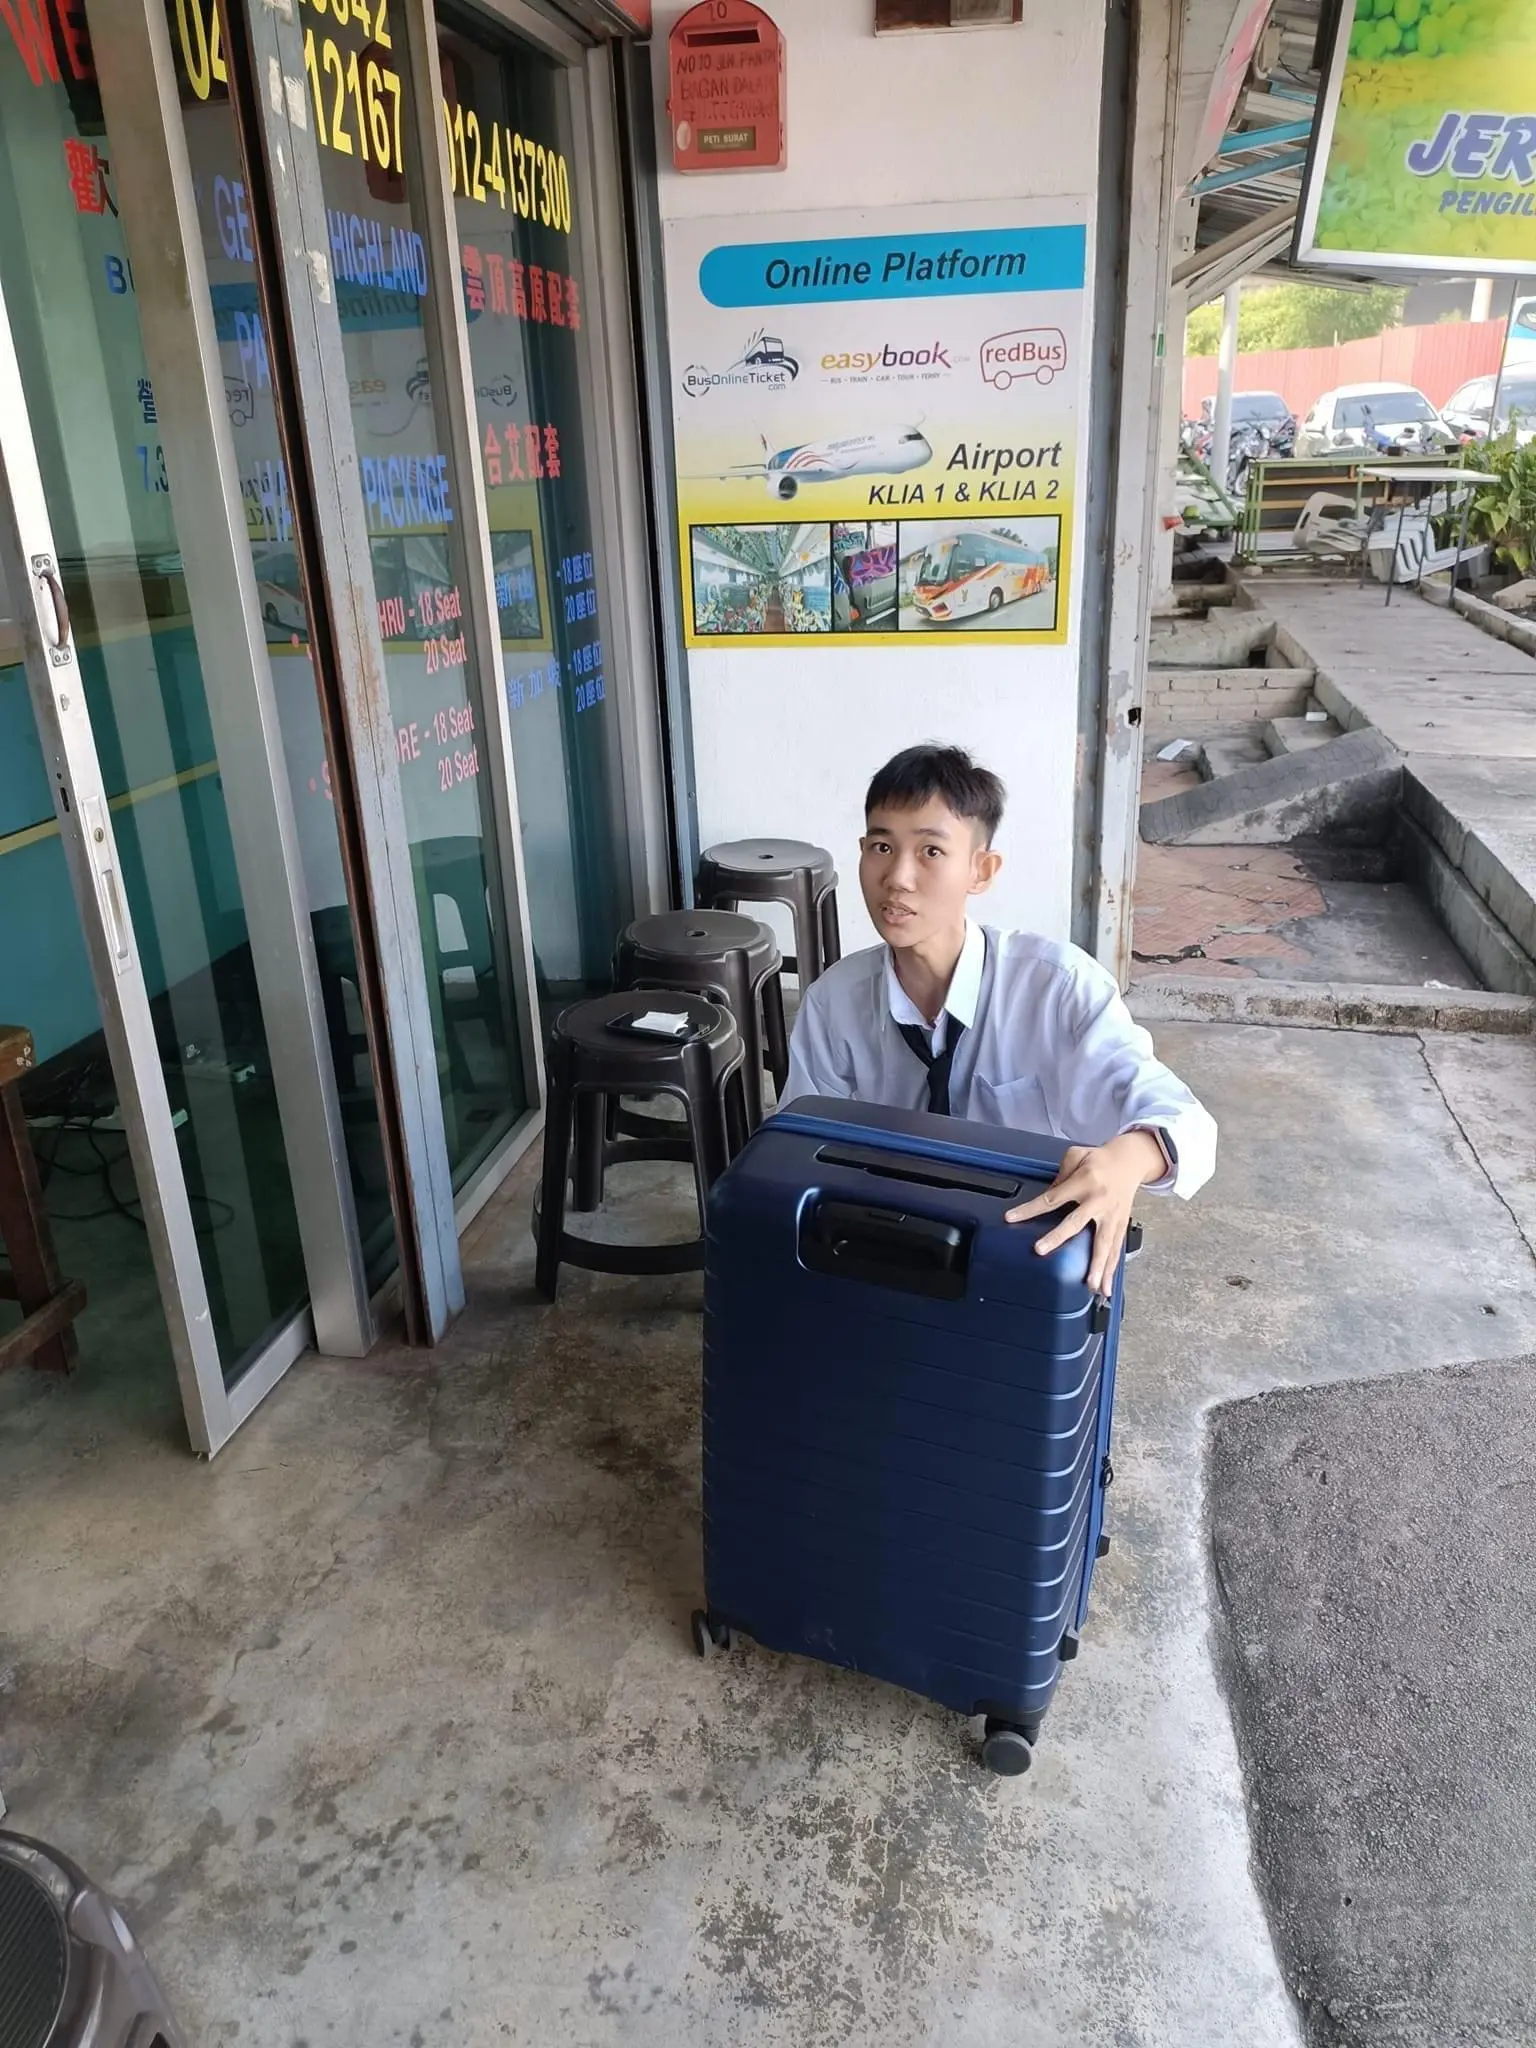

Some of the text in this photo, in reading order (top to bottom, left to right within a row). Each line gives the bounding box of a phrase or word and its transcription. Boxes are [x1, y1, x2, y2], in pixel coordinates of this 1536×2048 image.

[706, 1, 728, 21] 10
[304, 28, 403, 173] 12167
[327, 208, 428, 296] HIGHLAND
[765, 247, 1027, 289] Online Platform
[985, 342, 1061, 364] redBus
[688, 372, 786, 386] BusOnlineTicket
[946, 441, 1062, 476] Airport
[362, 454, 453, 531] PACKAGE
[868, 480, 1059, 505] KLIA 1 & KLIA 2
[418, 591, 434, 627] 18
[435, 586, 462, 622] Seat
[423, 632, 467, 674] 20 Seat
[433, 712, 447, 746] 18
[448, 702, 475, 739] Seat
[438, 743, 480, 792] 20 Seat
